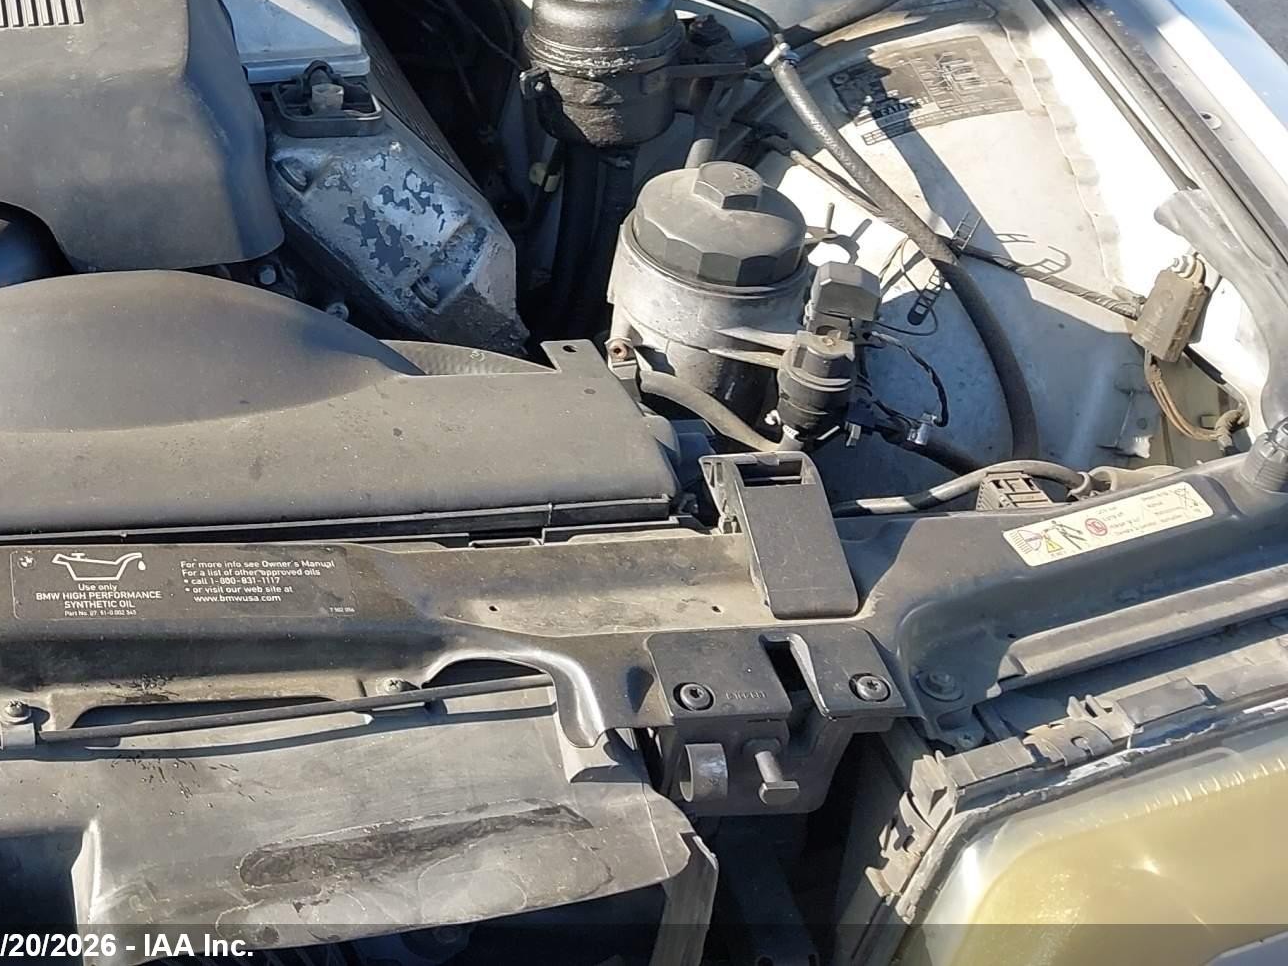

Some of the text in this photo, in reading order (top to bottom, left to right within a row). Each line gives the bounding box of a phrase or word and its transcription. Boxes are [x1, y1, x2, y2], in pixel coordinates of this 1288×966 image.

[180, 560, 196, 569] For
[224, 560, 242, 568] info
[261, 560, 300, 568] Owner's
[301, 559, 335, 569] Manual
[181, 569, 198, 577] For
[260, 568, 303, 578] approved
[304, 568, 321, 576] oils
[190, 577, 208, 585] call
[78, 583, 118, 593] Use only
[192, 586, 202, 594] or
[204, 585, 224, 594] visit
[243, 585, 263, 593] web
[265, 585, 282, 593] site
[283, 585, 294, 593] at
[36, 590, 162, 600] BMW HIGH PERFORMANCE
[193, 594, 282, 603] www.bmwusa.com
[64, 600, 136, 609] SYNTHETIC OIL
